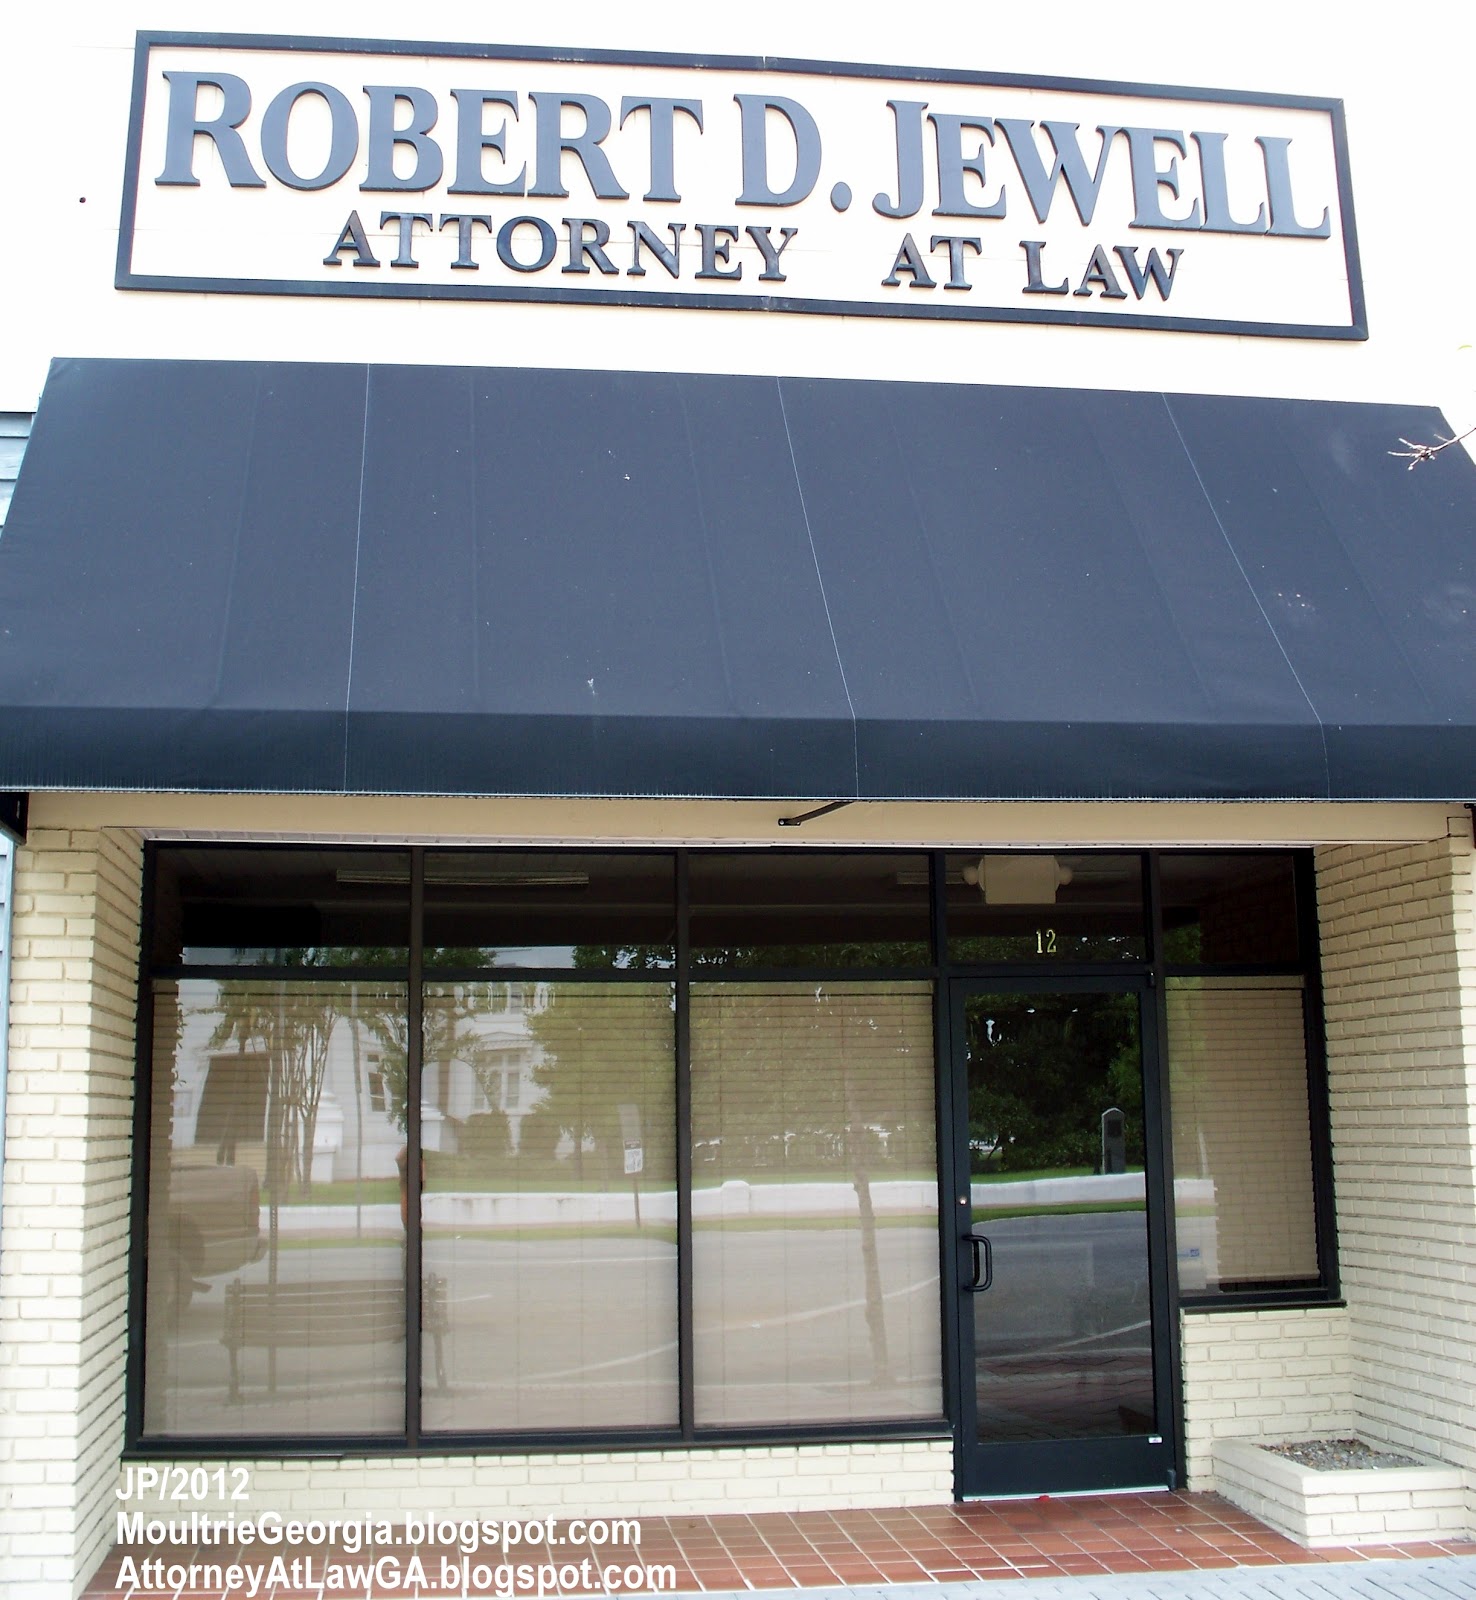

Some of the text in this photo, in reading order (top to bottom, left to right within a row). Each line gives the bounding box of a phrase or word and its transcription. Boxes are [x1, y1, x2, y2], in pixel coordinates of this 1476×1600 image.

[154, 70, 1332, 239] ROBERT D. JEWELL
[322, 209, 1185, 301] ATTORNEY AT LAW
[1035, 928, 1057, 954] 12
